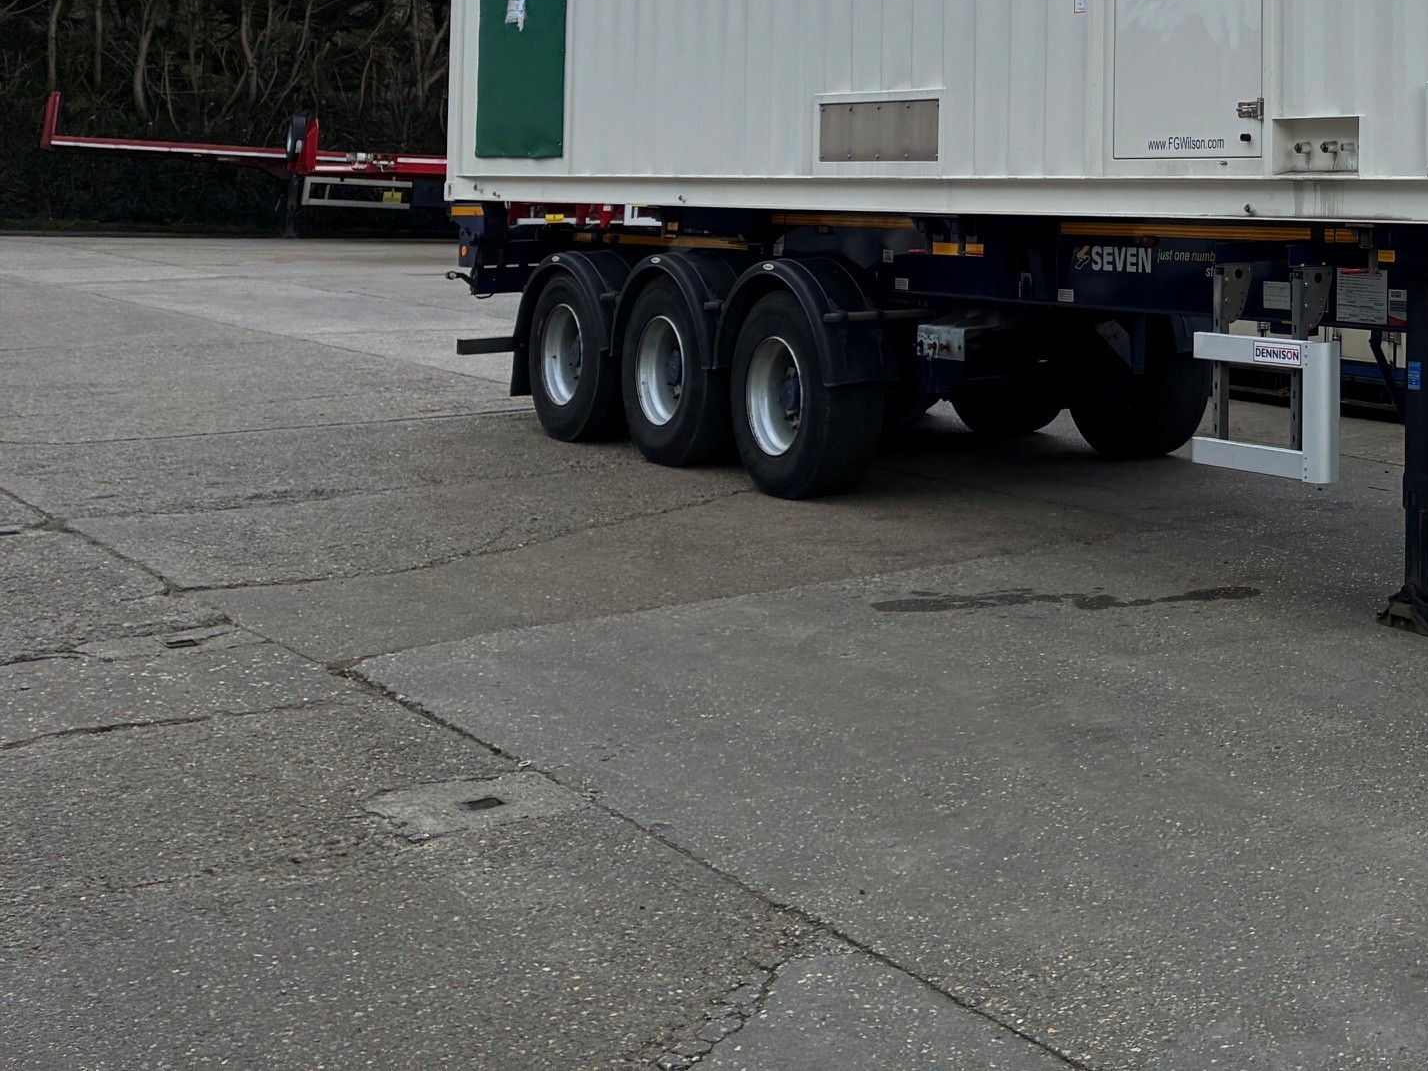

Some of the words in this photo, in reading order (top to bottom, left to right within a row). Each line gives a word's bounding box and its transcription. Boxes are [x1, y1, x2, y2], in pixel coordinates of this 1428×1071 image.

[1147, 136, 1225, 151] www.FGWilson.com
[1091, 245, 1152, 273] SEVEN
[1157, 249, 1173, 263] just
[1174, 251, 1190, 261] one
[1255, 347, 1299, 360] DENNISON
